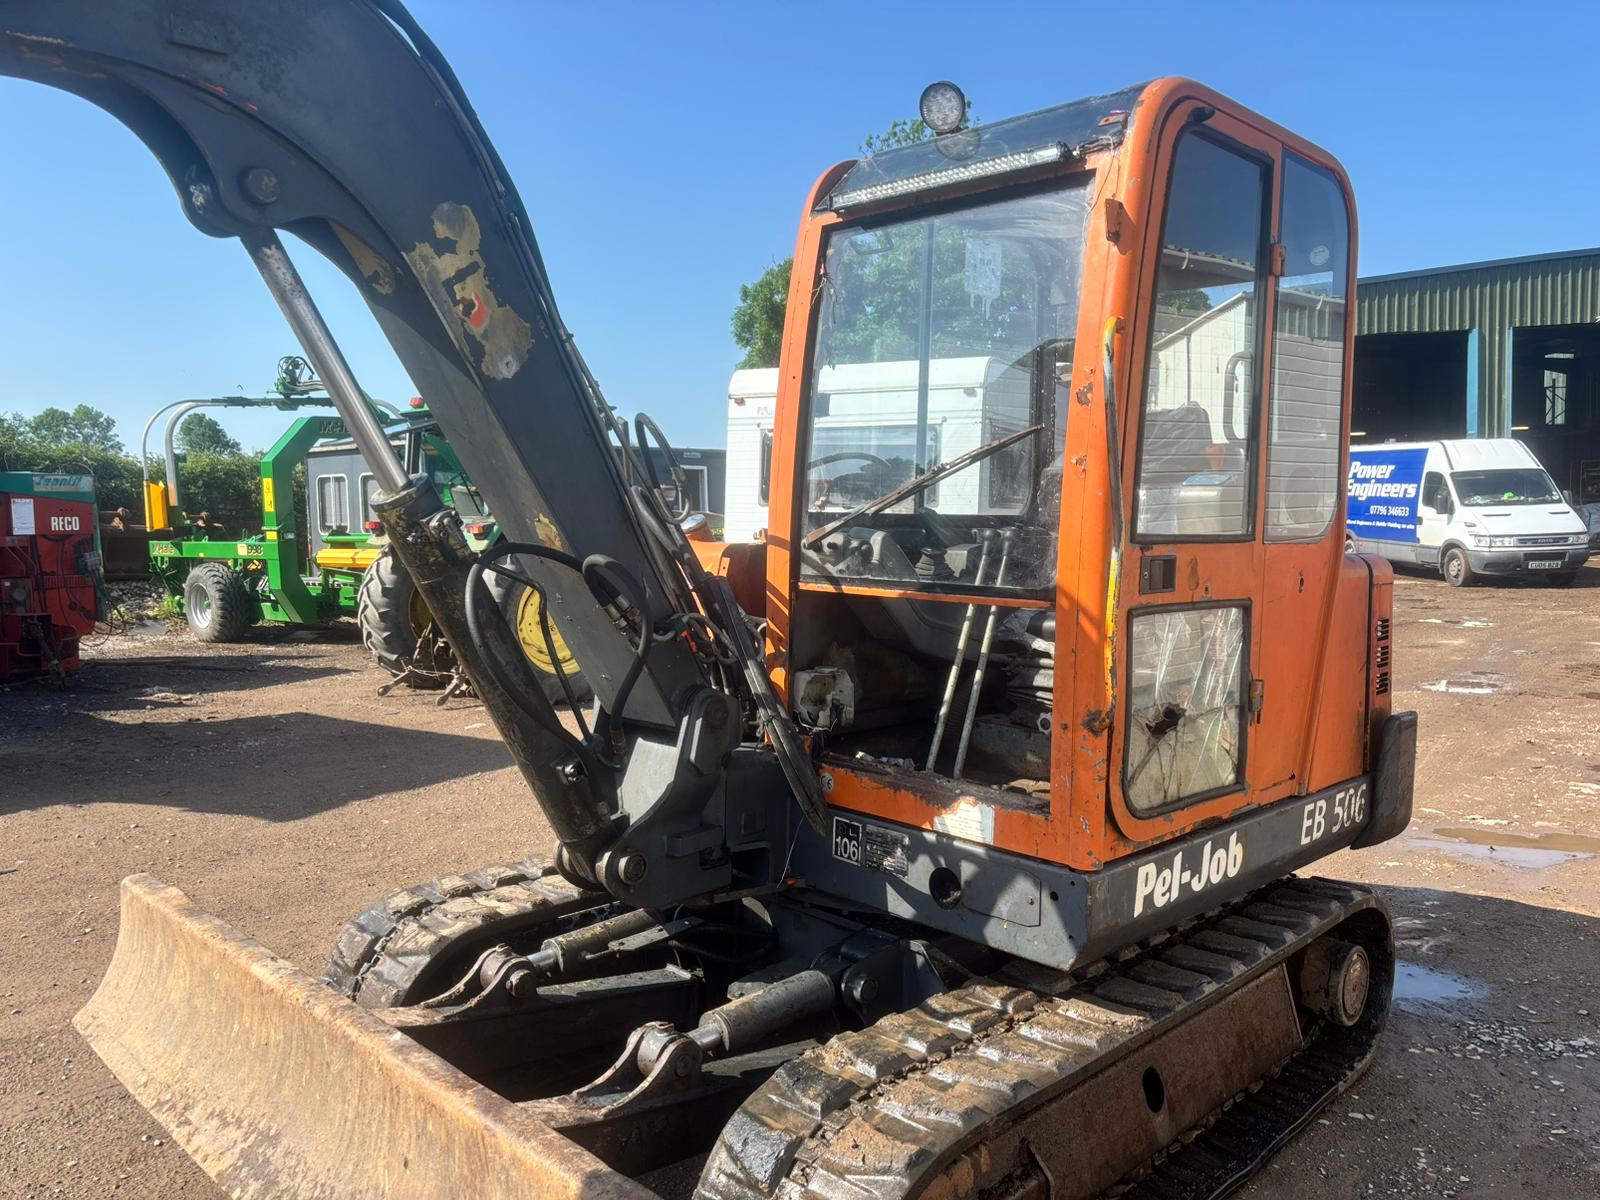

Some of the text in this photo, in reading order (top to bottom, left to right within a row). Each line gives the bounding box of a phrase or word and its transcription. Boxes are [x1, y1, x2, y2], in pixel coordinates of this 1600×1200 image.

[1348, 461, 1395, 478] Power
[1347, 479, 1418, 501] Engineers
[1370, 504, 1387, 516] 07796
[51, 516, 80, 531] RECO
[1300, 783, 1367, 846] EB 506
[836, 835, 858, 861] 106
[1134, 832, 1243, 919] Pel-Job
